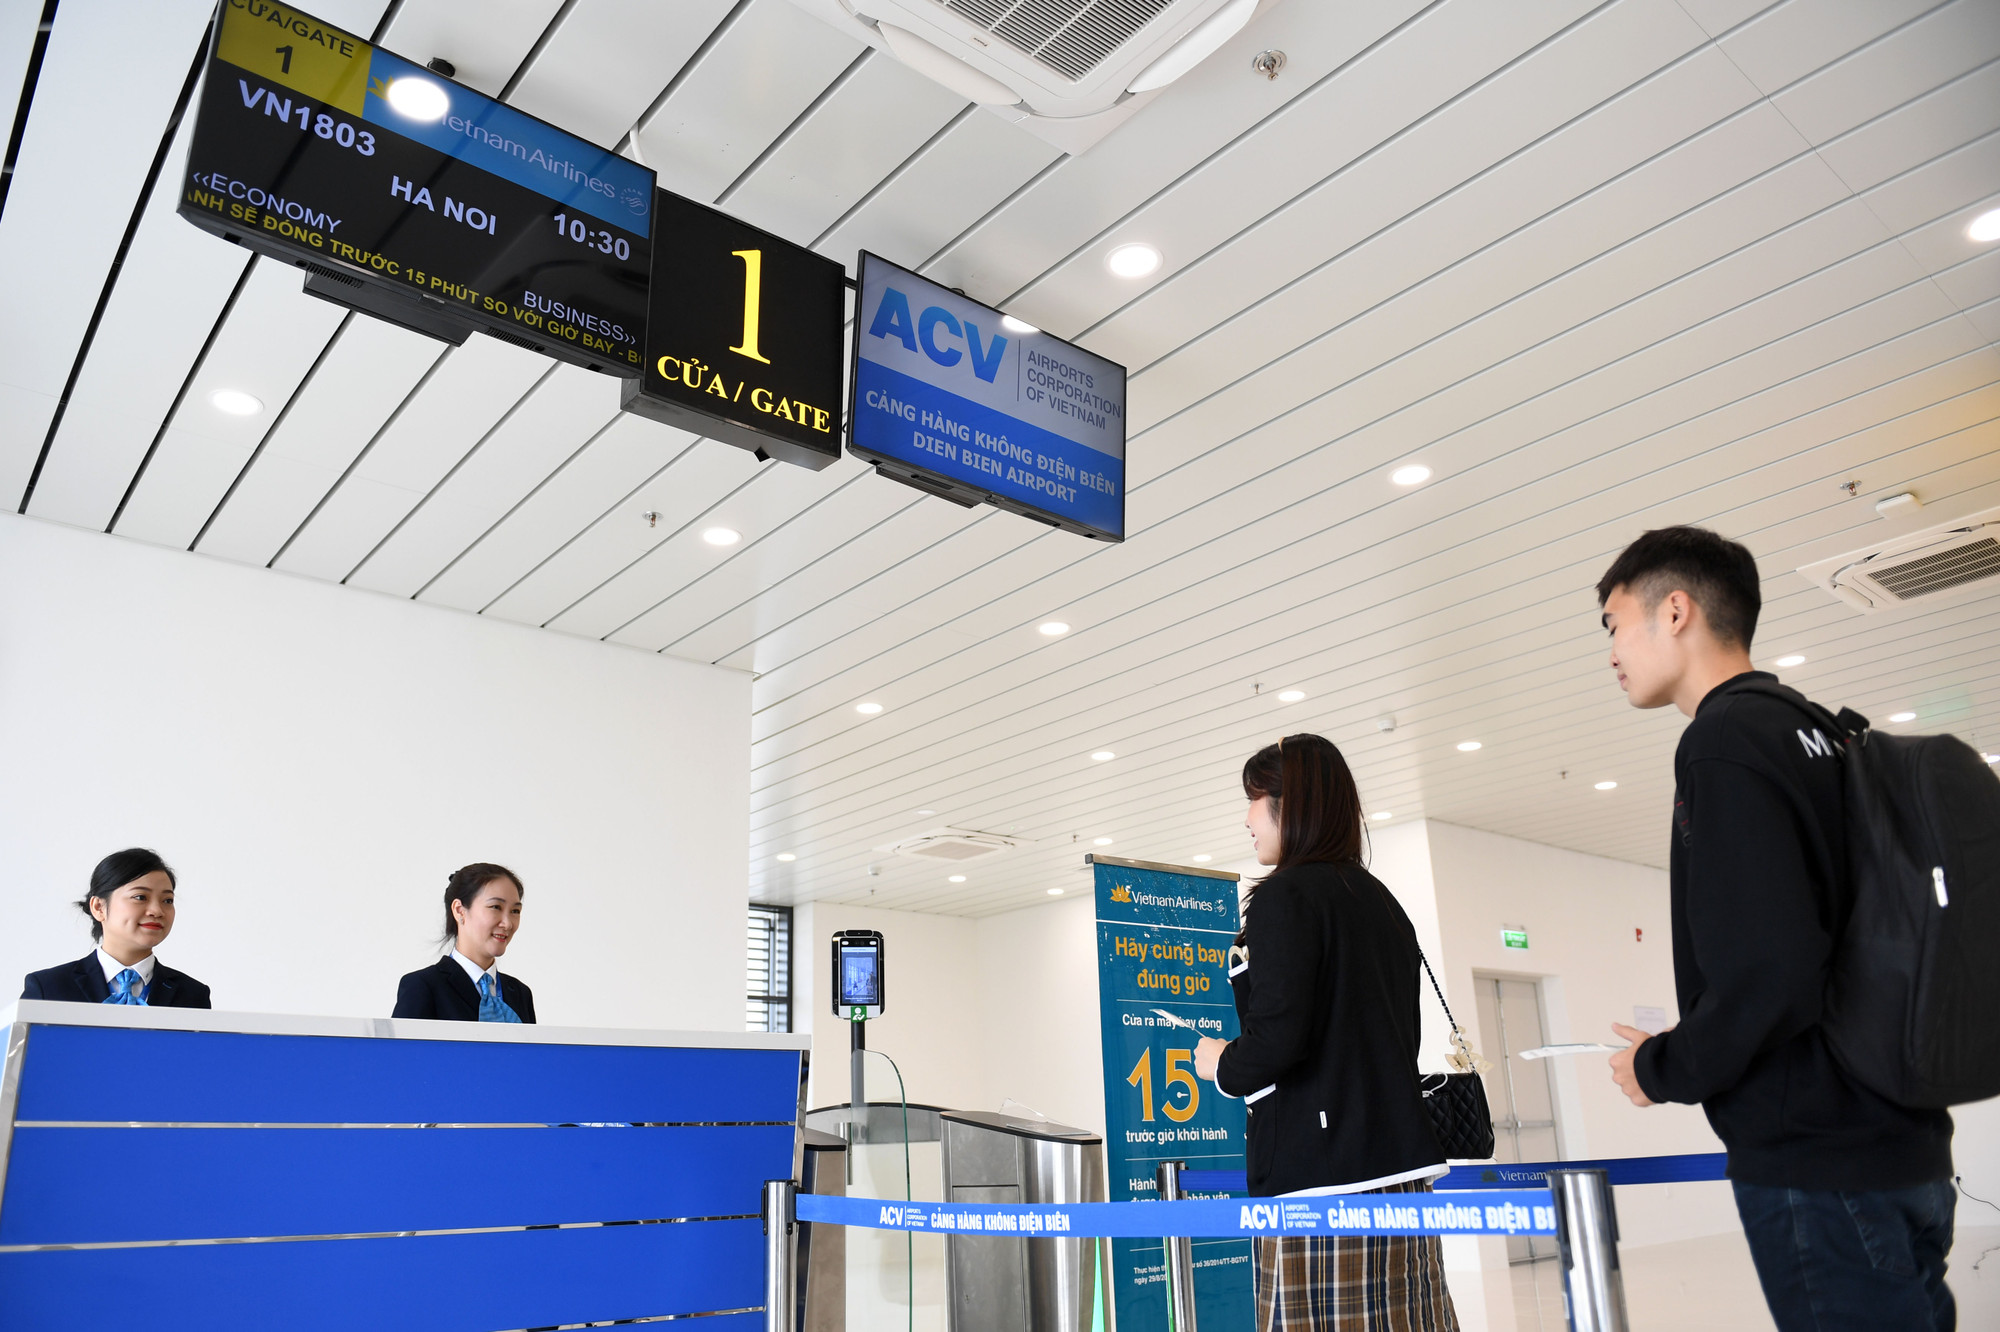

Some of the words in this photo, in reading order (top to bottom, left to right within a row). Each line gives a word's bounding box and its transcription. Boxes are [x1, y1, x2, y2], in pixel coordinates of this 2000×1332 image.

[275, 45, 293, 74] 1
[239, 79, 376, 157] VN1803
[441, 110, 526, 160] ietnam
[529, 149, 616, 199] Airlines
[391, 175, 435, 212] HA
[443, 196, 497, 235] NOI
[553, 213, 630, 261] 10:30
[188, 189, 224, 212] NH
[230, 203, 258, 225] SẼ
[263, 215, 323, 248] ĐÓNG
[330, 238, 400, 275] TRƯỚC
[406, 268, 425, 285] 15
[430, 276, 479, 304] PHÚT
[483, 296, 508, 315] SO
[513, 306, 543, 329] VỚI
[548, 320, 578, 341] GIỜ
[583, 333, 615, 355] BAY
[729, 249, 771, 365] 1
[868, 286, 1009, 384] ACV
[1027, 350, 1094, 389] AIRPORTS
[750, 387, 831, 434] GATE
[1026, 386, 1045, 403] OF
[1048, 394, 1106, 430] VIETNAM
[1027, 367, 1121, 418] CORPORATION
[865, 389, 916, 422] CẢNG
[921, 410, 970, 442] HÀNG
[975, 430, 1033, 465] KHÔNG
[1036, 454, 1075, 482] ĐIỆN
[1079, 470, 1115, 496] BIÊN
[913, 431, 957, 461] DIEN
[962, 449, 1002, 477] BIEN
[1006, 466, 1077, 503] AIRPORT
[1796, 728, 1834, 758] M
[1131, 890, 1175, 907] Vietnam
[1175, 895, 1213, 912] Airlines
[1115, 936, 1148, 963] Hãy
[1152, 940, 1194, 966] cùng
[1198, 943, 1226, 968] bay
[1137, 968, 1181, 995] đúng
[1184, 972, 1211, 995] giờ
[1144, 1017, 1155, 1026] ra
[1198, 1017, 1222, 1031] đóng
[1126, 1046, 1200, 1122] 15
[1125, 1129, 1155, 1143] trước
[1157, 1129, 1175, 1145] giờ
[1176, 1127, 1200, 1141] khởi
[1201, 1127, 1228, 1141] hành
[1128, 1178, 1157, 1191] Hành
[1499, 1170, 1549, 1182] Vietnam
[880, 1206, 903, 1226] ACV
[931, 1207, 955, 1229] CẢNG
[957, 1211, 982, 1231] HÀNG
[984, 1211, 1018, 1231] KHÔNG
[1019, 1211, 1043, 1235] ĐIỆN
[1045, 1211, 1071, 1232] BIÊN
[1240, 1204, 1279, 1230] ACV
[1285, 1204, 1309, 1212] AIRPORTS
[1286, 1212, 1322, 1220] CORPORATION
[1327, 1199, 1371, 1229] CẢNG
[1373, 1203, 1420, 1229] HÀNG
[1421, 1202, 1483, 1229] KHÔNG
[1485, 1201, 1531, 1235] ĐIỆN
[1532, 1205, 1557, 1230] BI
